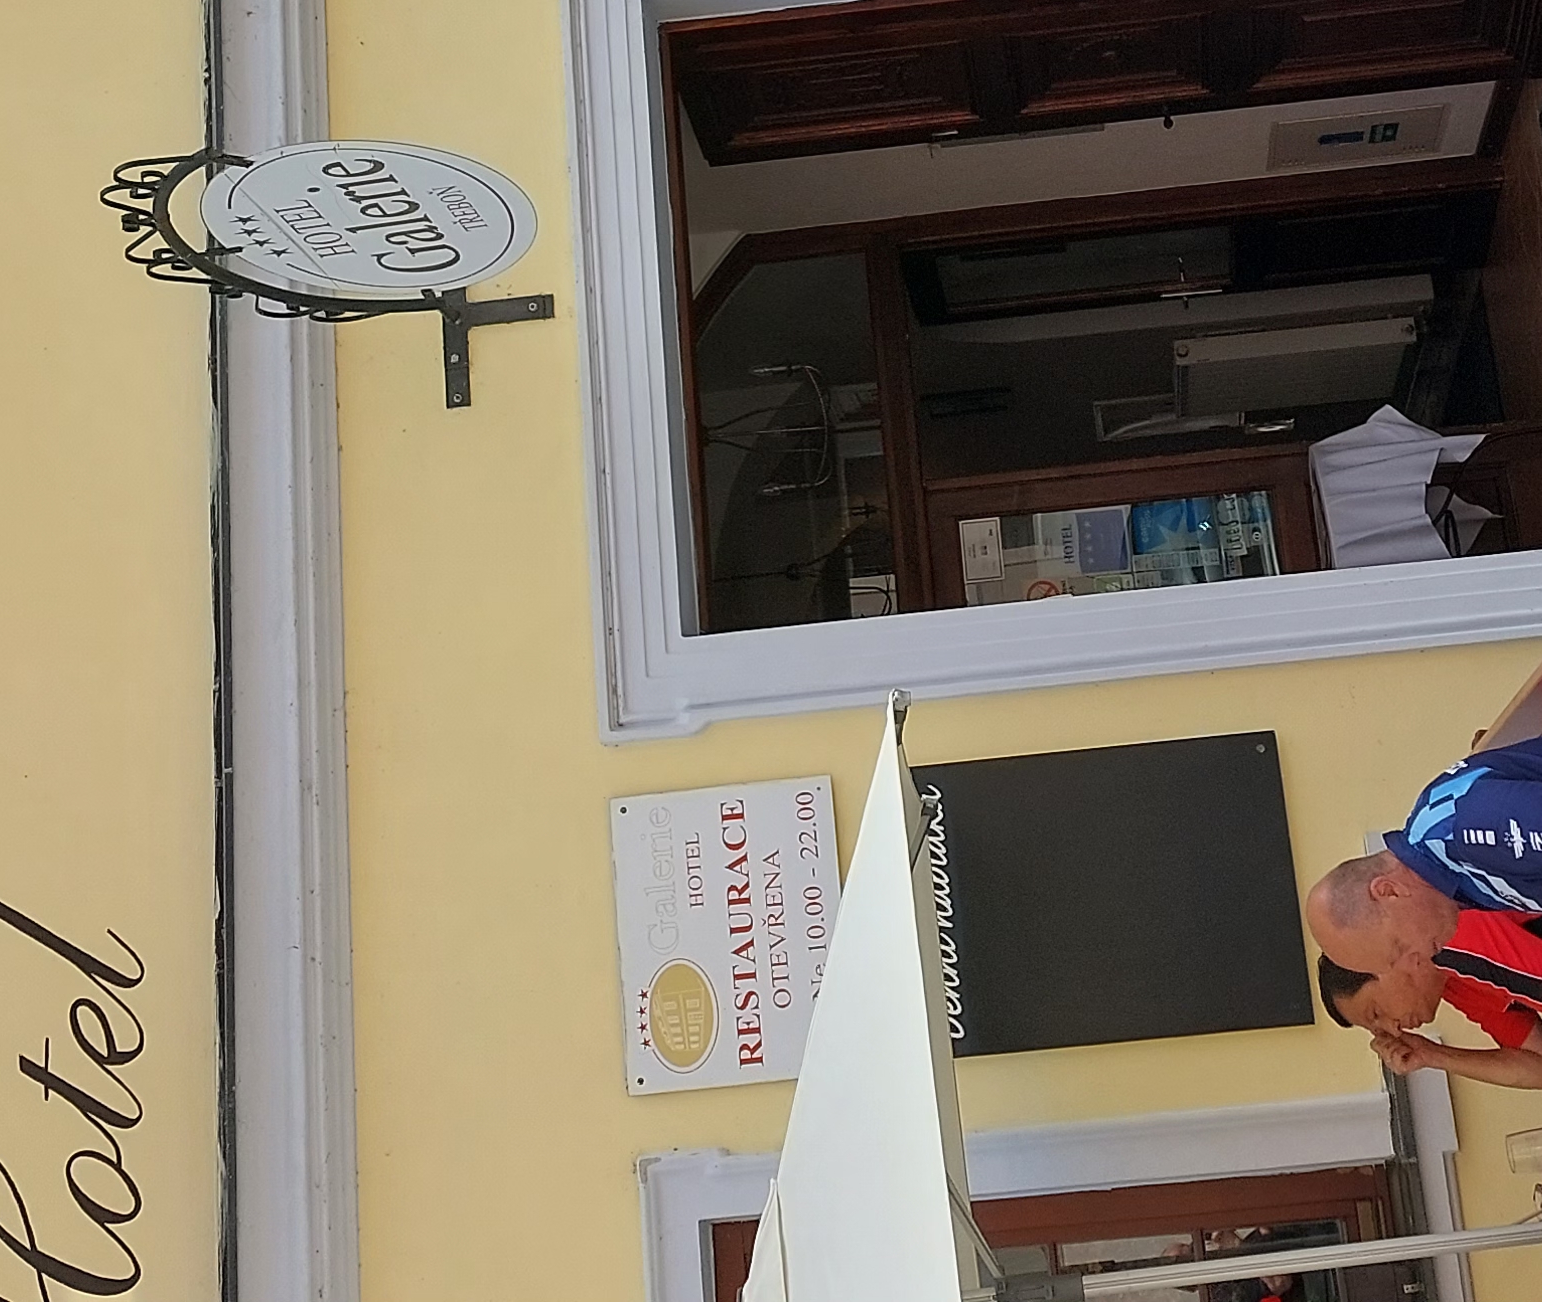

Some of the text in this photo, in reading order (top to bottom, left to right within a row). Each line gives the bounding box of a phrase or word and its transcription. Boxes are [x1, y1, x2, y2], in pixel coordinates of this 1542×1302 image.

[273, 199, 357, 258] HOTEL
[306, 156, 461, 273] Galerie
[427, 184, 489, 233] TŘEBOŇ
[1061, 523, 1076, 564] HOTEL
[795, 790, 821, 859] 22.00
[640, 806, 680, 956] Galerie
[685, 832, 705, 909] HOTEL
[719, 798, 765, 1070] RESTAURACE
[761, 849, 792, 1009] OTEVŘENA
[802, 885, 828, 952] 10.00
